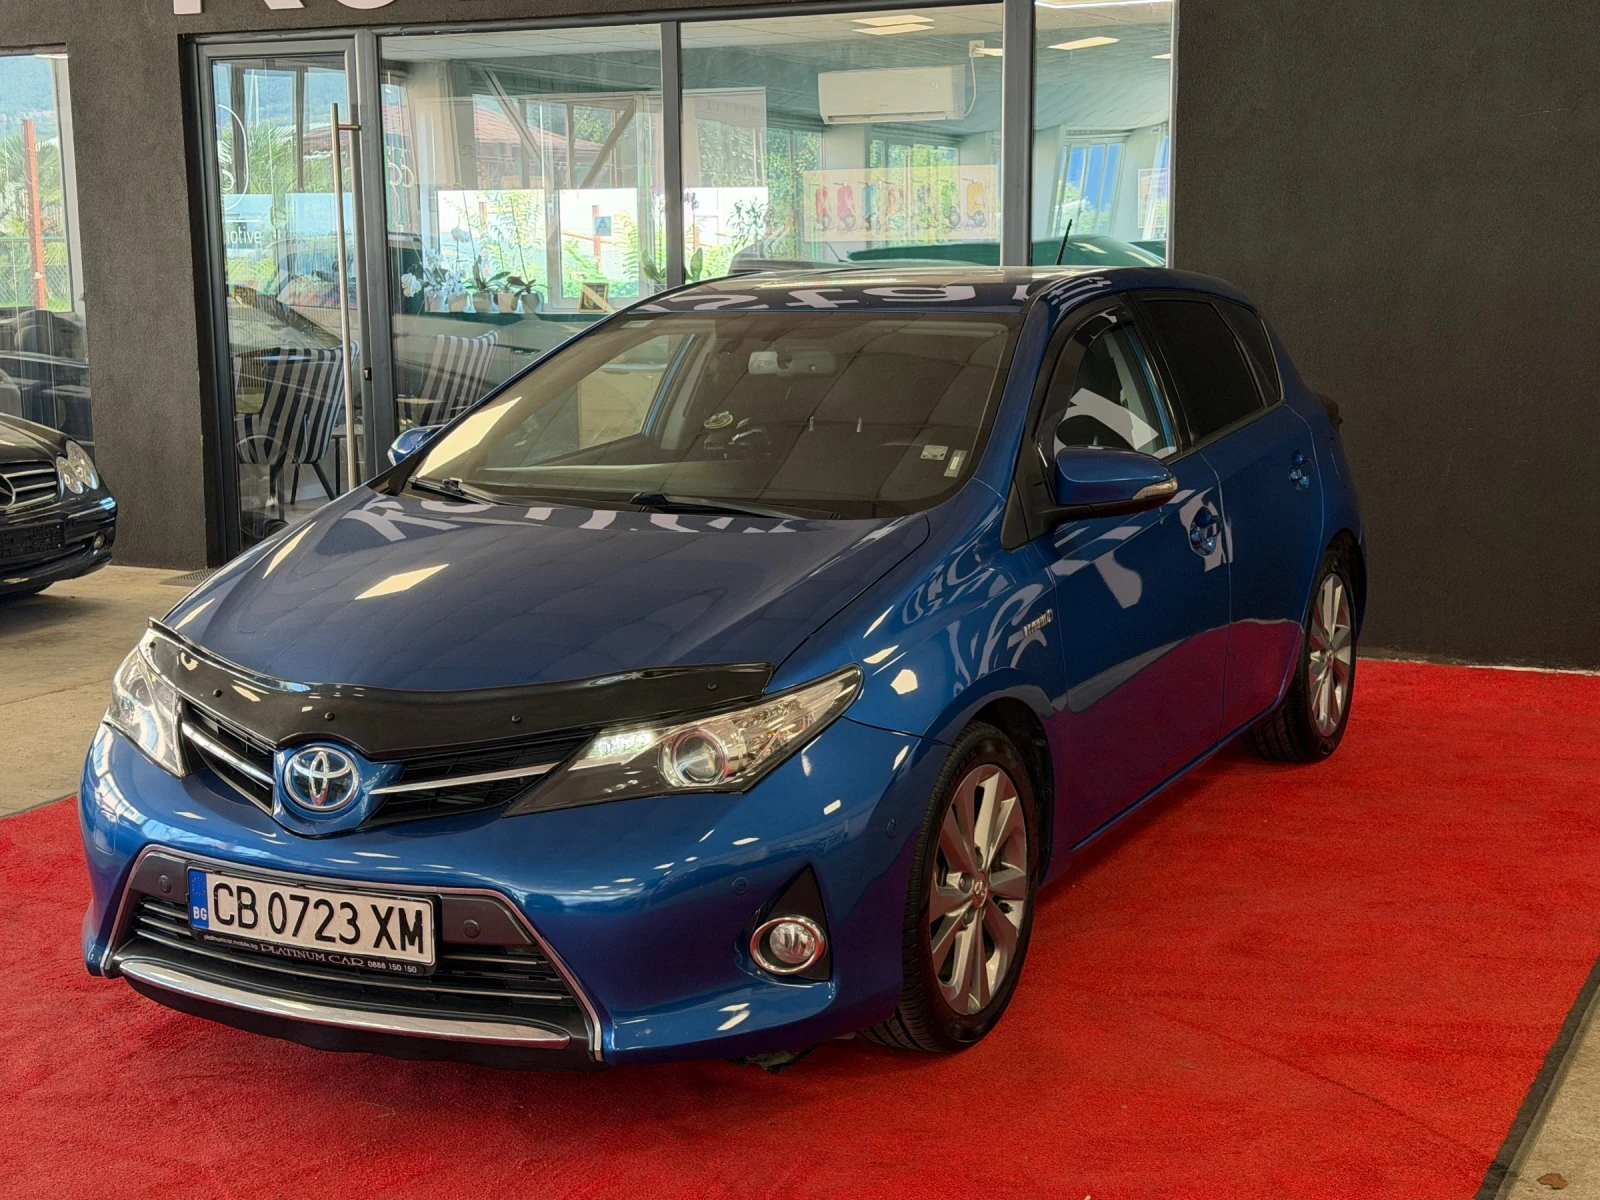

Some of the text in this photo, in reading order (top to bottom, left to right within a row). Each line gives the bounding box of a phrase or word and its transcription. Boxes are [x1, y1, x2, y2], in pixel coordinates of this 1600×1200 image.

[193, 905, 208, 921] BG
[213, 882, 424, 954] CB 0723 XM
[260, 944, 326, 962] PLATINUM
[327, 955, 366, 968] CAR
[388, 962, 402, 972] 150
